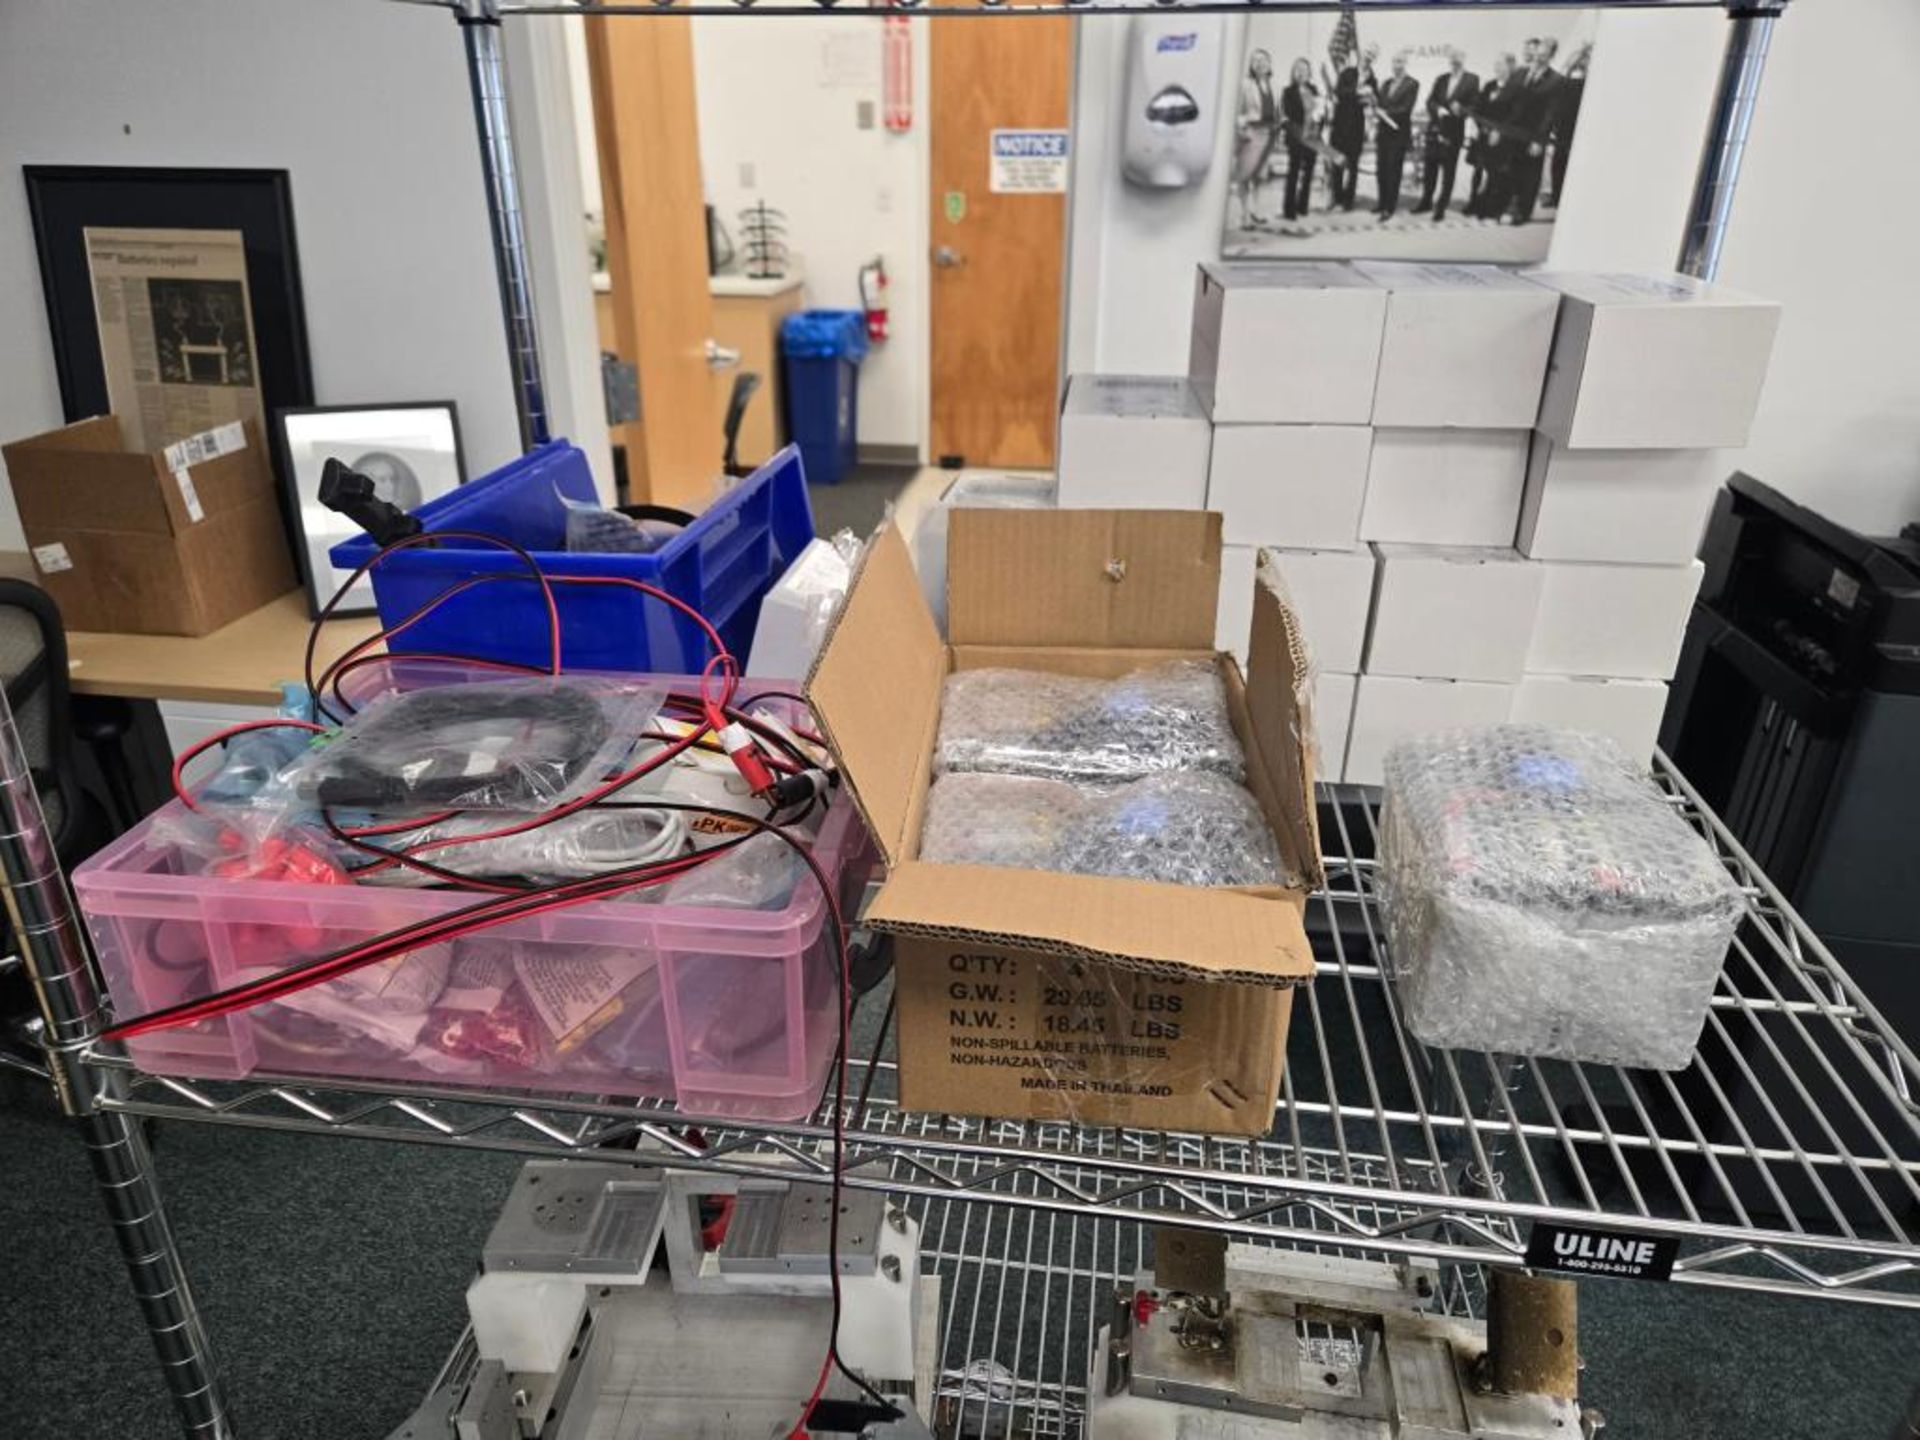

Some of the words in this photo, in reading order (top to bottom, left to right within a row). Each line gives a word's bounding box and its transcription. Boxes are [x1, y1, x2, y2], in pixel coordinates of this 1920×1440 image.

[998, 136, 1063, 154] NOTICE
[1133, 992, 1183, 1013] LBS
[1131, 1020, 1181, 1040] LBS
[950, 1036, 1076, 1053] NON-SPILLABLE
[1020, 1078, 1067, 1091] MADE
[1071, 1080, 1088, 1092] IN
[1091, 1080, 1173, 1097] THAILAND
[1553, 1232, 1656, 1264] ULINE
